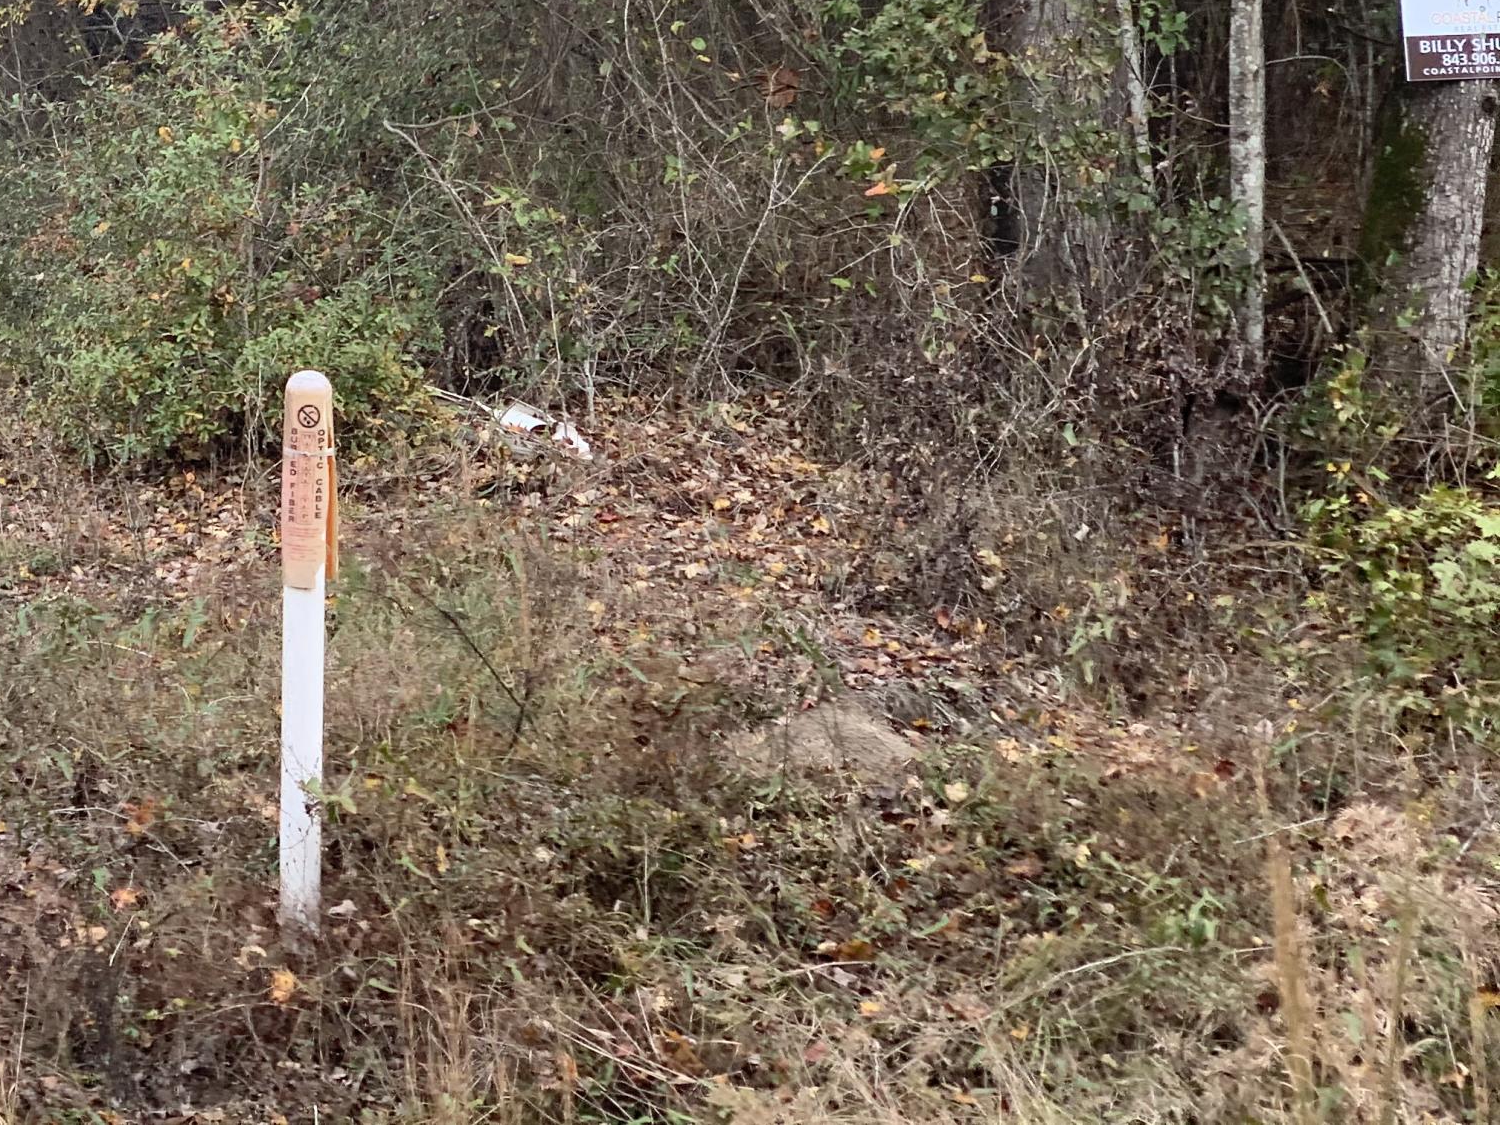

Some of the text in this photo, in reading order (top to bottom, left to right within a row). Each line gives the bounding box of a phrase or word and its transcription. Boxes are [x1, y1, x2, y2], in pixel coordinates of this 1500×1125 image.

[1419, 39, 1466, 53] BILLY
[315, 429, 325, 518] OPTIC CABLE
[288, 483, 296, 522] FIBER
